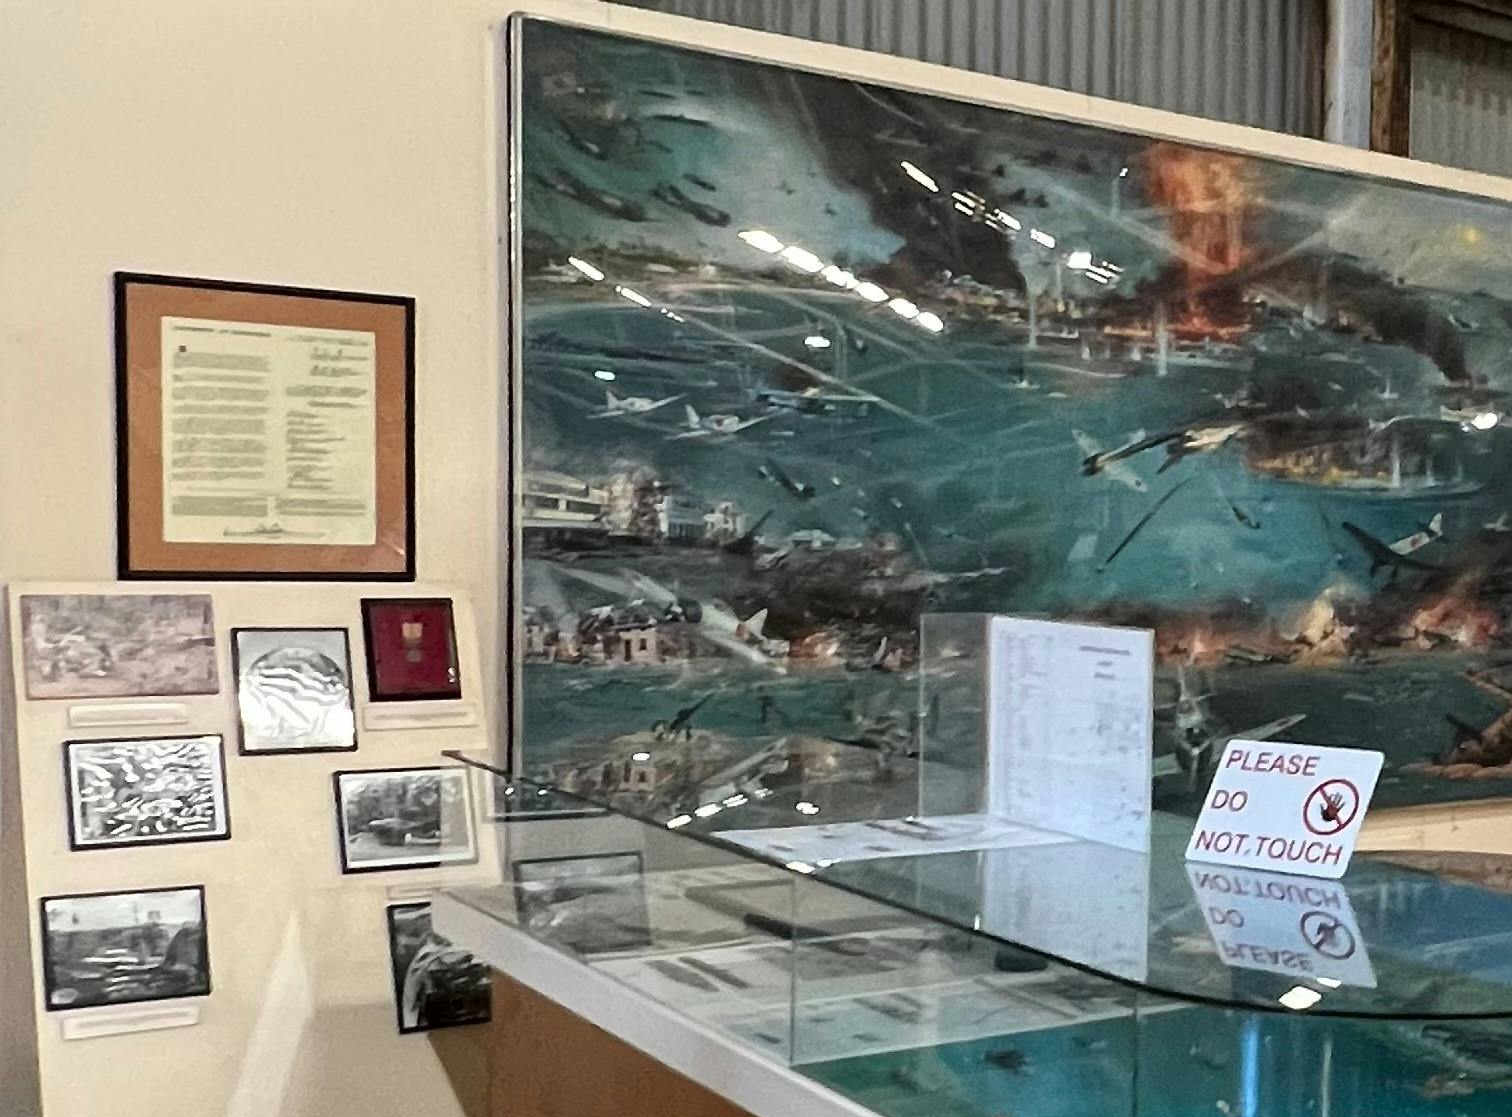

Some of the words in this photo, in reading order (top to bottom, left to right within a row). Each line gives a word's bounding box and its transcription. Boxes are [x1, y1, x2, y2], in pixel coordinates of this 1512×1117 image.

[1225, 750, 1320, 777] PLEASE
[1210, 789, 1249, 812] DO
[1194, 830, 1250, 855] NOT
[1254, 836, 1343, 865] TOUCH
